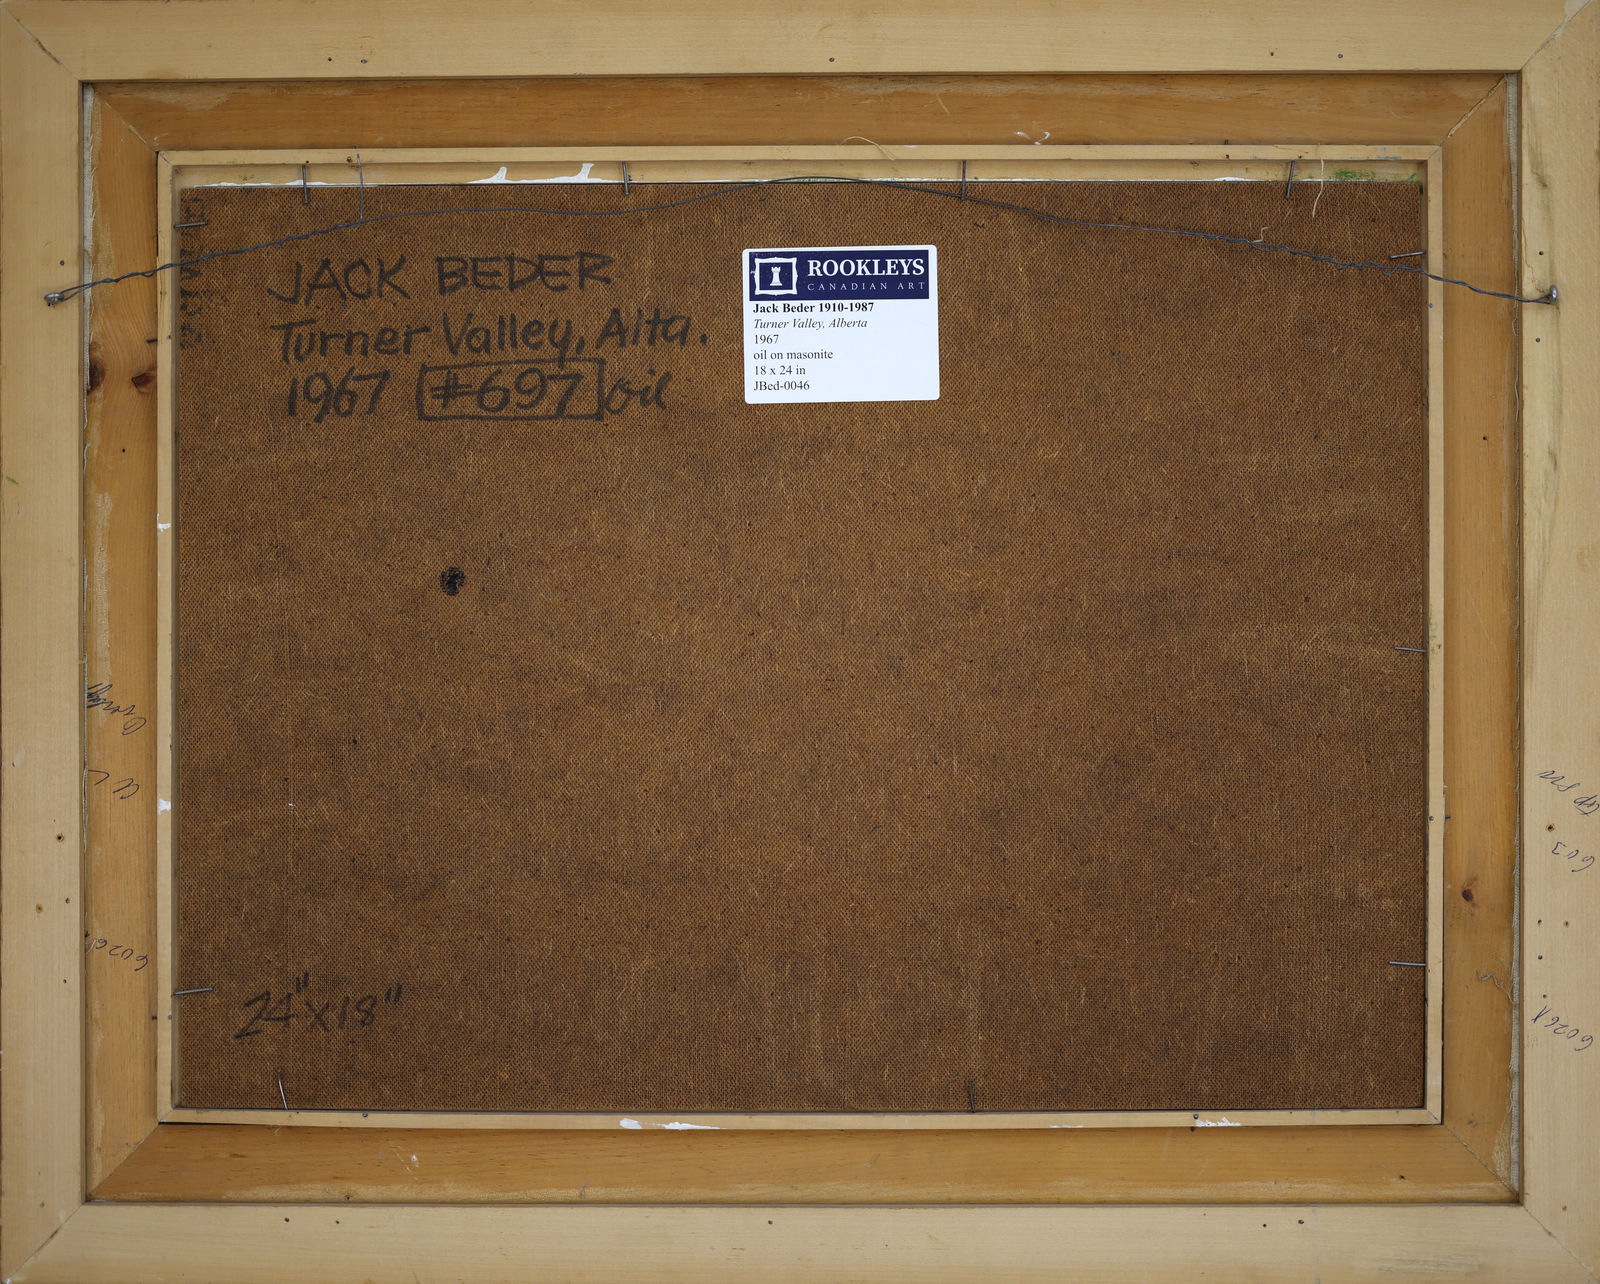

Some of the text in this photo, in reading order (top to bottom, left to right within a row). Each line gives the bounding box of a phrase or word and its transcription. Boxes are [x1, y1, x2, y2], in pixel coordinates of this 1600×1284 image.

[807, 258, 925, 277] ROOKLEYS
[267, 250, 615, 307] JACK BEDER
[807, 281, 925, 291] CANADIAN ART
[752, 302, 874, 313] Jack Beder 1910-1987
[753, 318, 868, 330] Turner Valley, Alberta
[269, 308, 708, 368] Turner Valley, Alta.
[754, 334, 779, 345] 1967
[753, 349, 834, 360] oil on masonite
[755, 365, 767, 376] 18
[779, 365, 792, 375] 24
[796, 365, 806, 375] in
[753, 380, 810, 391] JBed-0046
[287, 367, 672, 423] 1967 #697 oil
